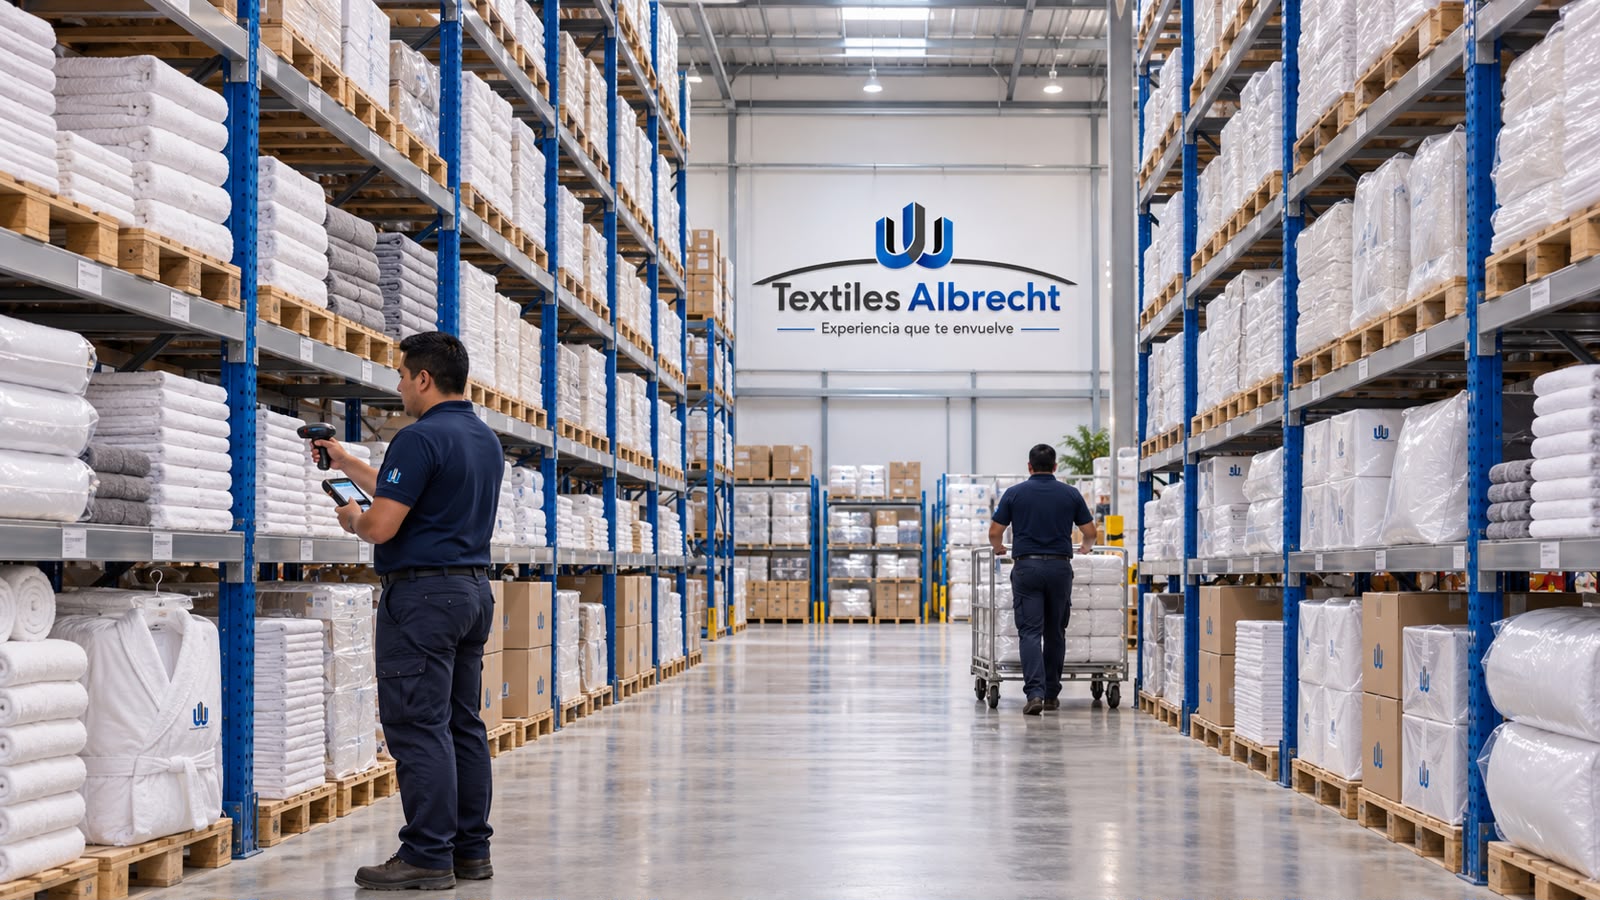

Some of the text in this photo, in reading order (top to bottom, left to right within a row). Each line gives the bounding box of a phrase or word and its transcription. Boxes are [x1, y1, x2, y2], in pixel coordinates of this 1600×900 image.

[772, 282, 1060, 312] Textiles Albrecht
[821, 322, 1014, 338] Experiencia que te envuelve
